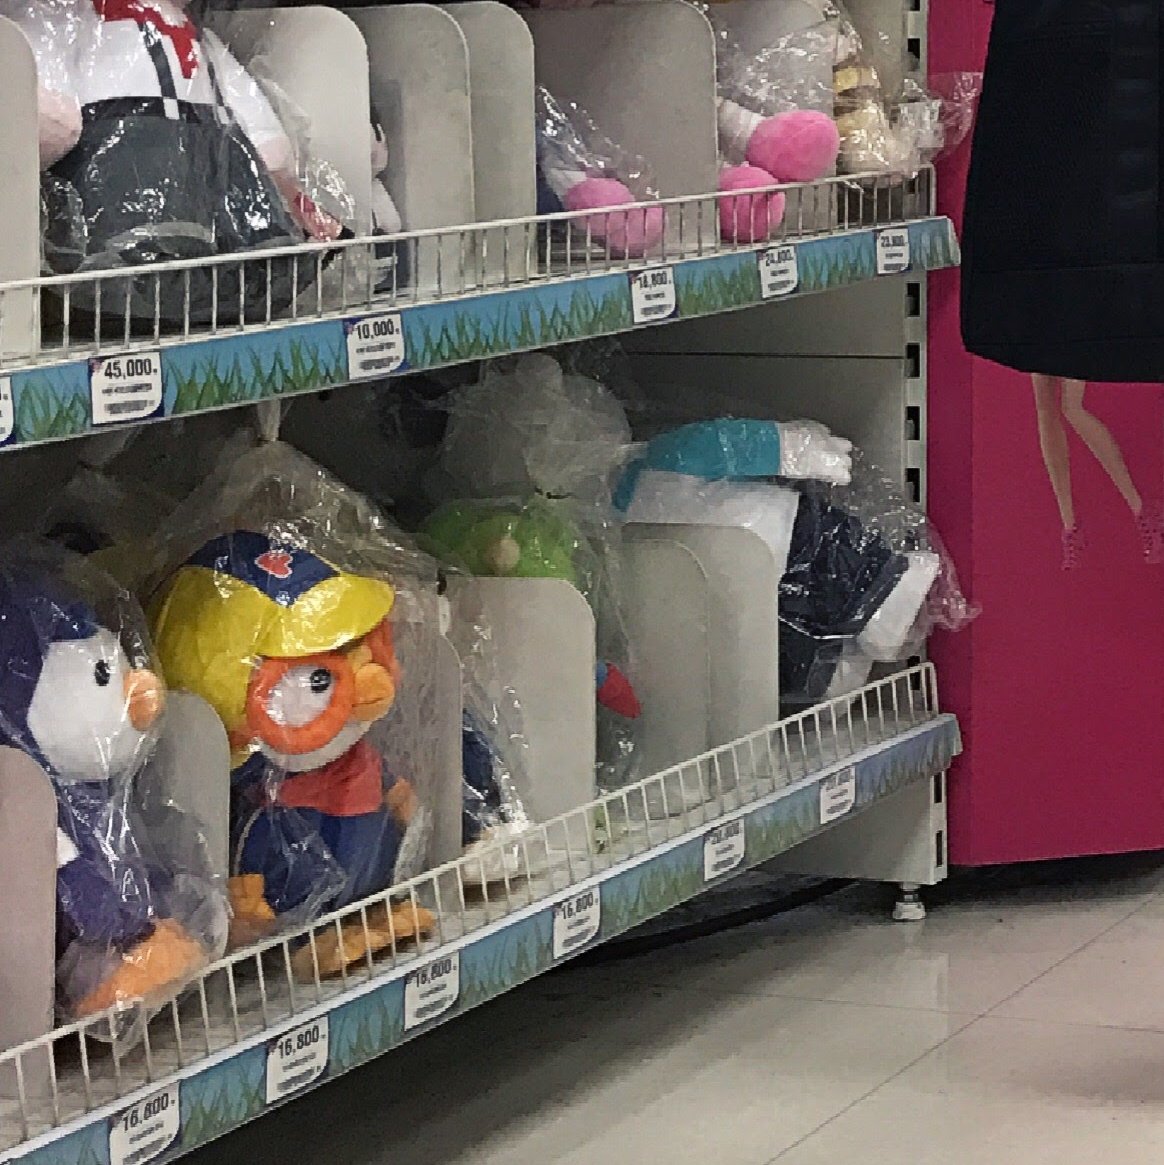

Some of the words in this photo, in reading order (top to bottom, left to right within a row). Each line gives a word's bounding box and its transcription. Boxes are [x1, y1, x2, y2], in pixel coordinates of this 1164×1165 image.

[356, 320, 395, 340] 10,000
[104, 358, 152, 380] 45,000
[278, 1025, 320, 1059] 16,800
